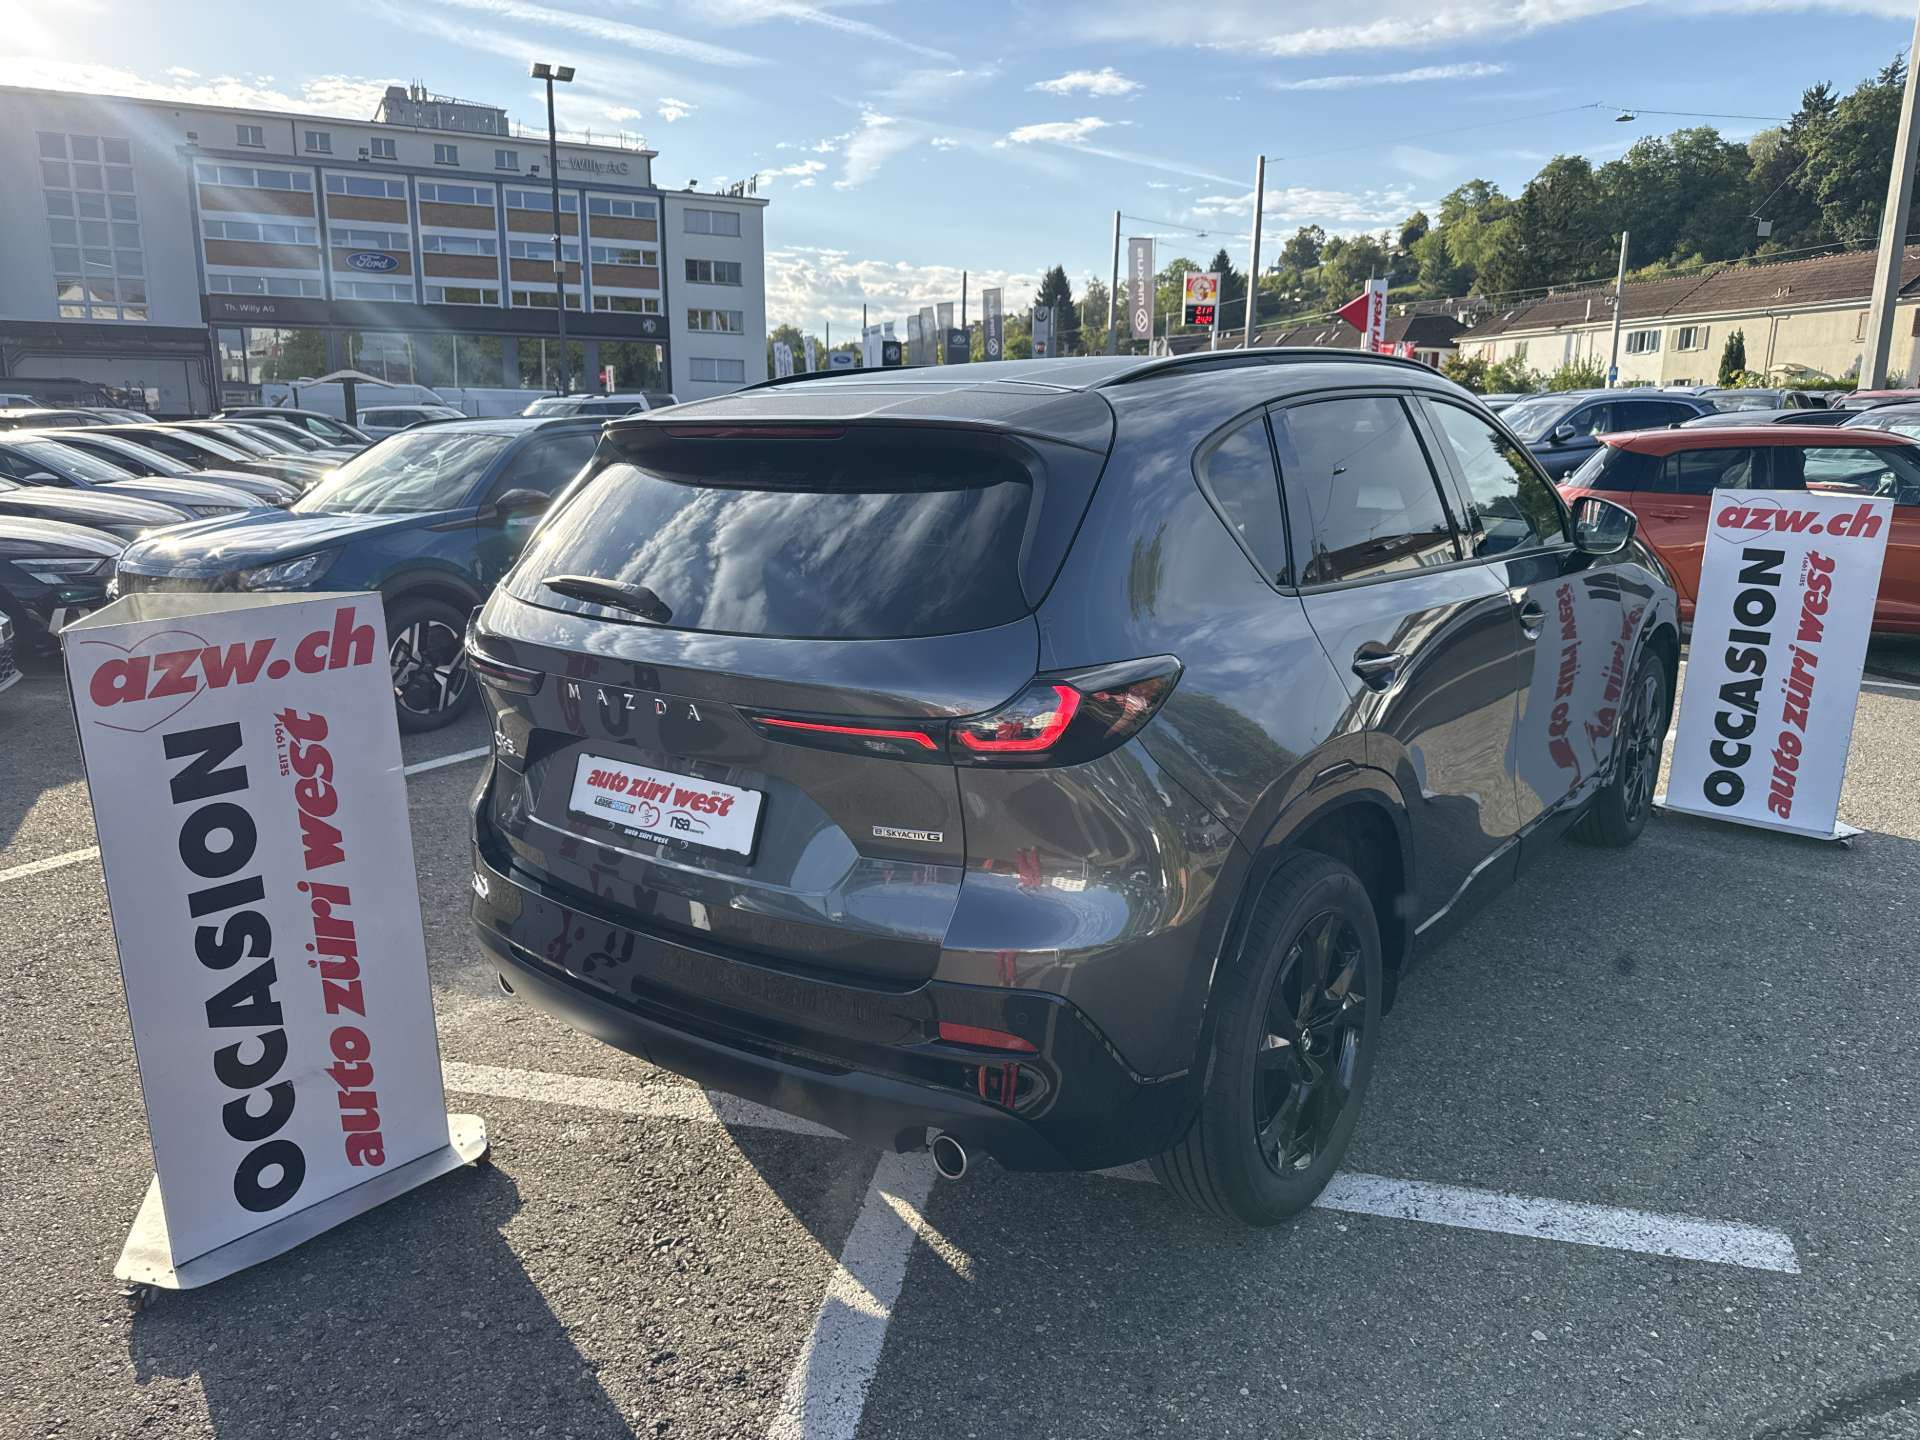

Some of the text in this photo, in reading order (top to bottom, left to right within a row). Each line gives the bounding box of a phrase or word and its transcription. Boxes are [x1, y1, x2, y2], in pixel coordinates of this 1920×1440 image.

[570, 158, 601, 176] Willy
[607, 160, 630, 176] AG
[356, 255, 389, 269] Ford
[224, 303, 276, 314] Th. Willy AG
[1716, 503, 1883, 538] azw.ch
[90, 606, 376, 707] azw.ch
[1703, 547, 1785, 807] OCCASION
[1768, 550, 1836, 819] auto züri west
[567, 682, 702, 722] MAZDA
[278, 752, 290, 777] SEIT
[586, 768, 736, 817] auto züri west
[623, 828, 670, 845] auto züri west
[669, 816, 690, 832] nsa
[273, 707, 386, 1167] auto züri west
[162, 721, 306, 1213] OCCASION
